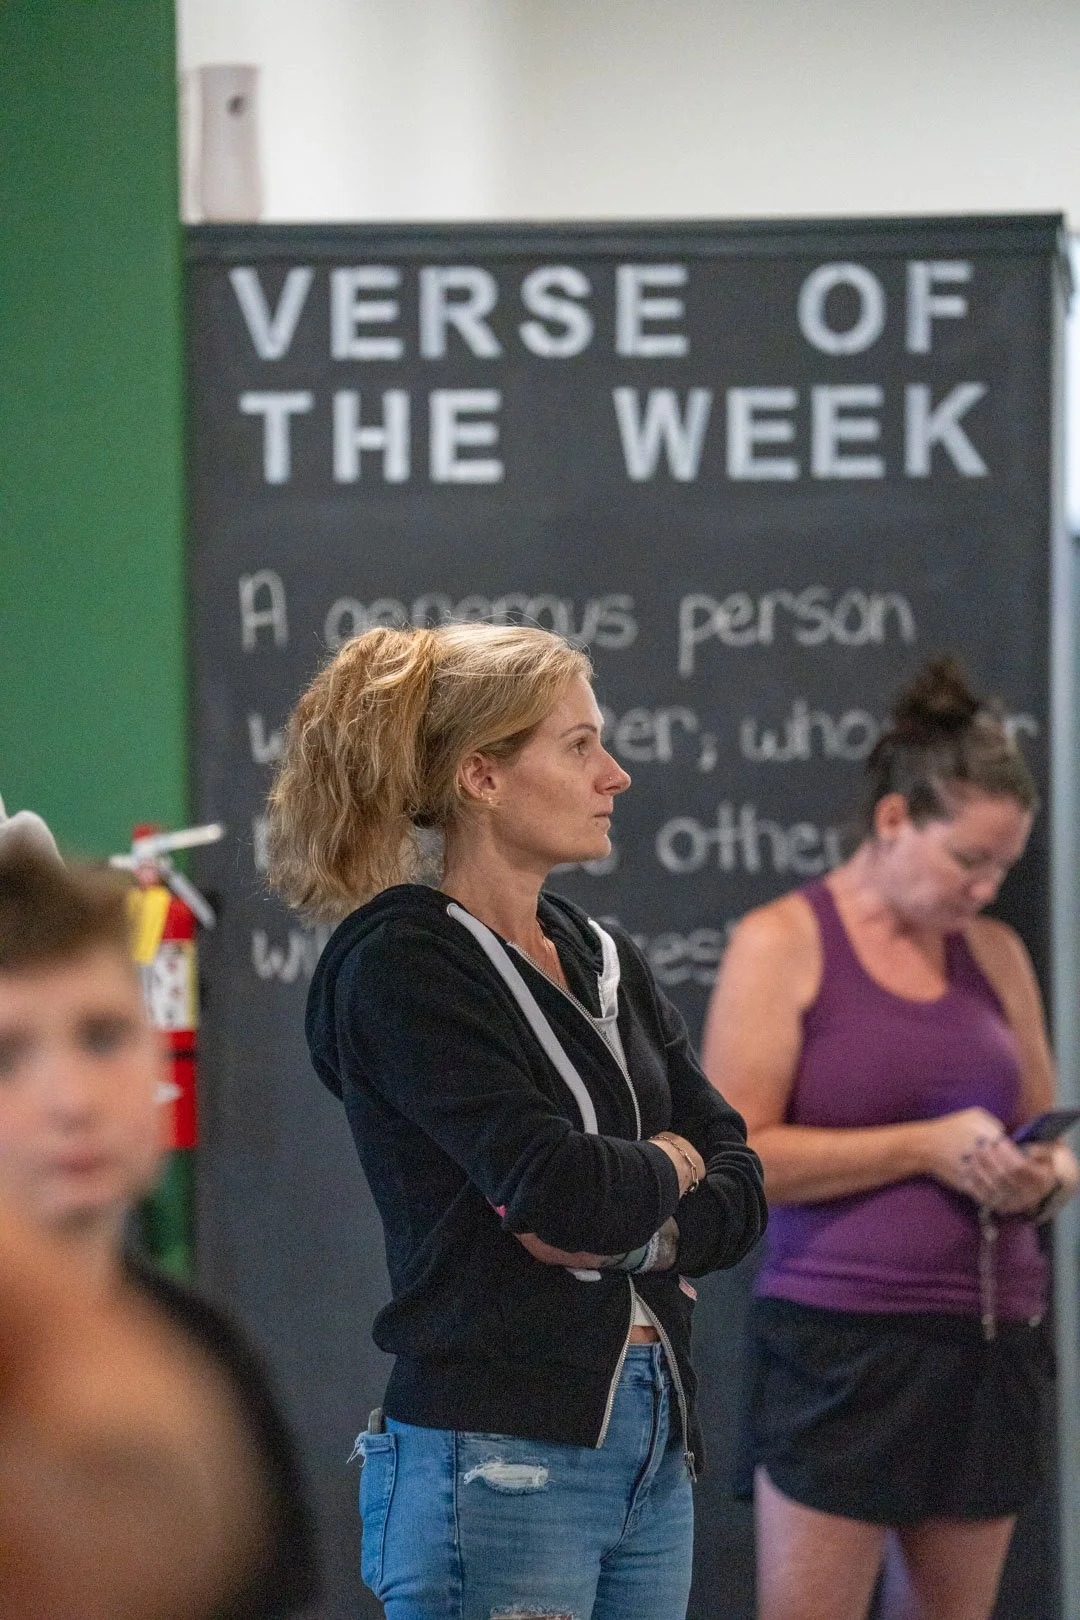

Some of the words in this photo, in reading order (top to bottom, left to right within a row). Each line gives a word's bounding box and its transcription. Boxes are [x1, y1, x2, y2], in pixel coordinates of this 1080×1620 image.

[229, 264, 690, 361] VERSE
[797, 261, 973, 355] OF
[239, 388, 503, 485] THE
[612, 382, 989, 482] WEEK
[238, 569, 288, 653] A
[678, 586, 916, 678] person
[655, 800, 848, 874] other
